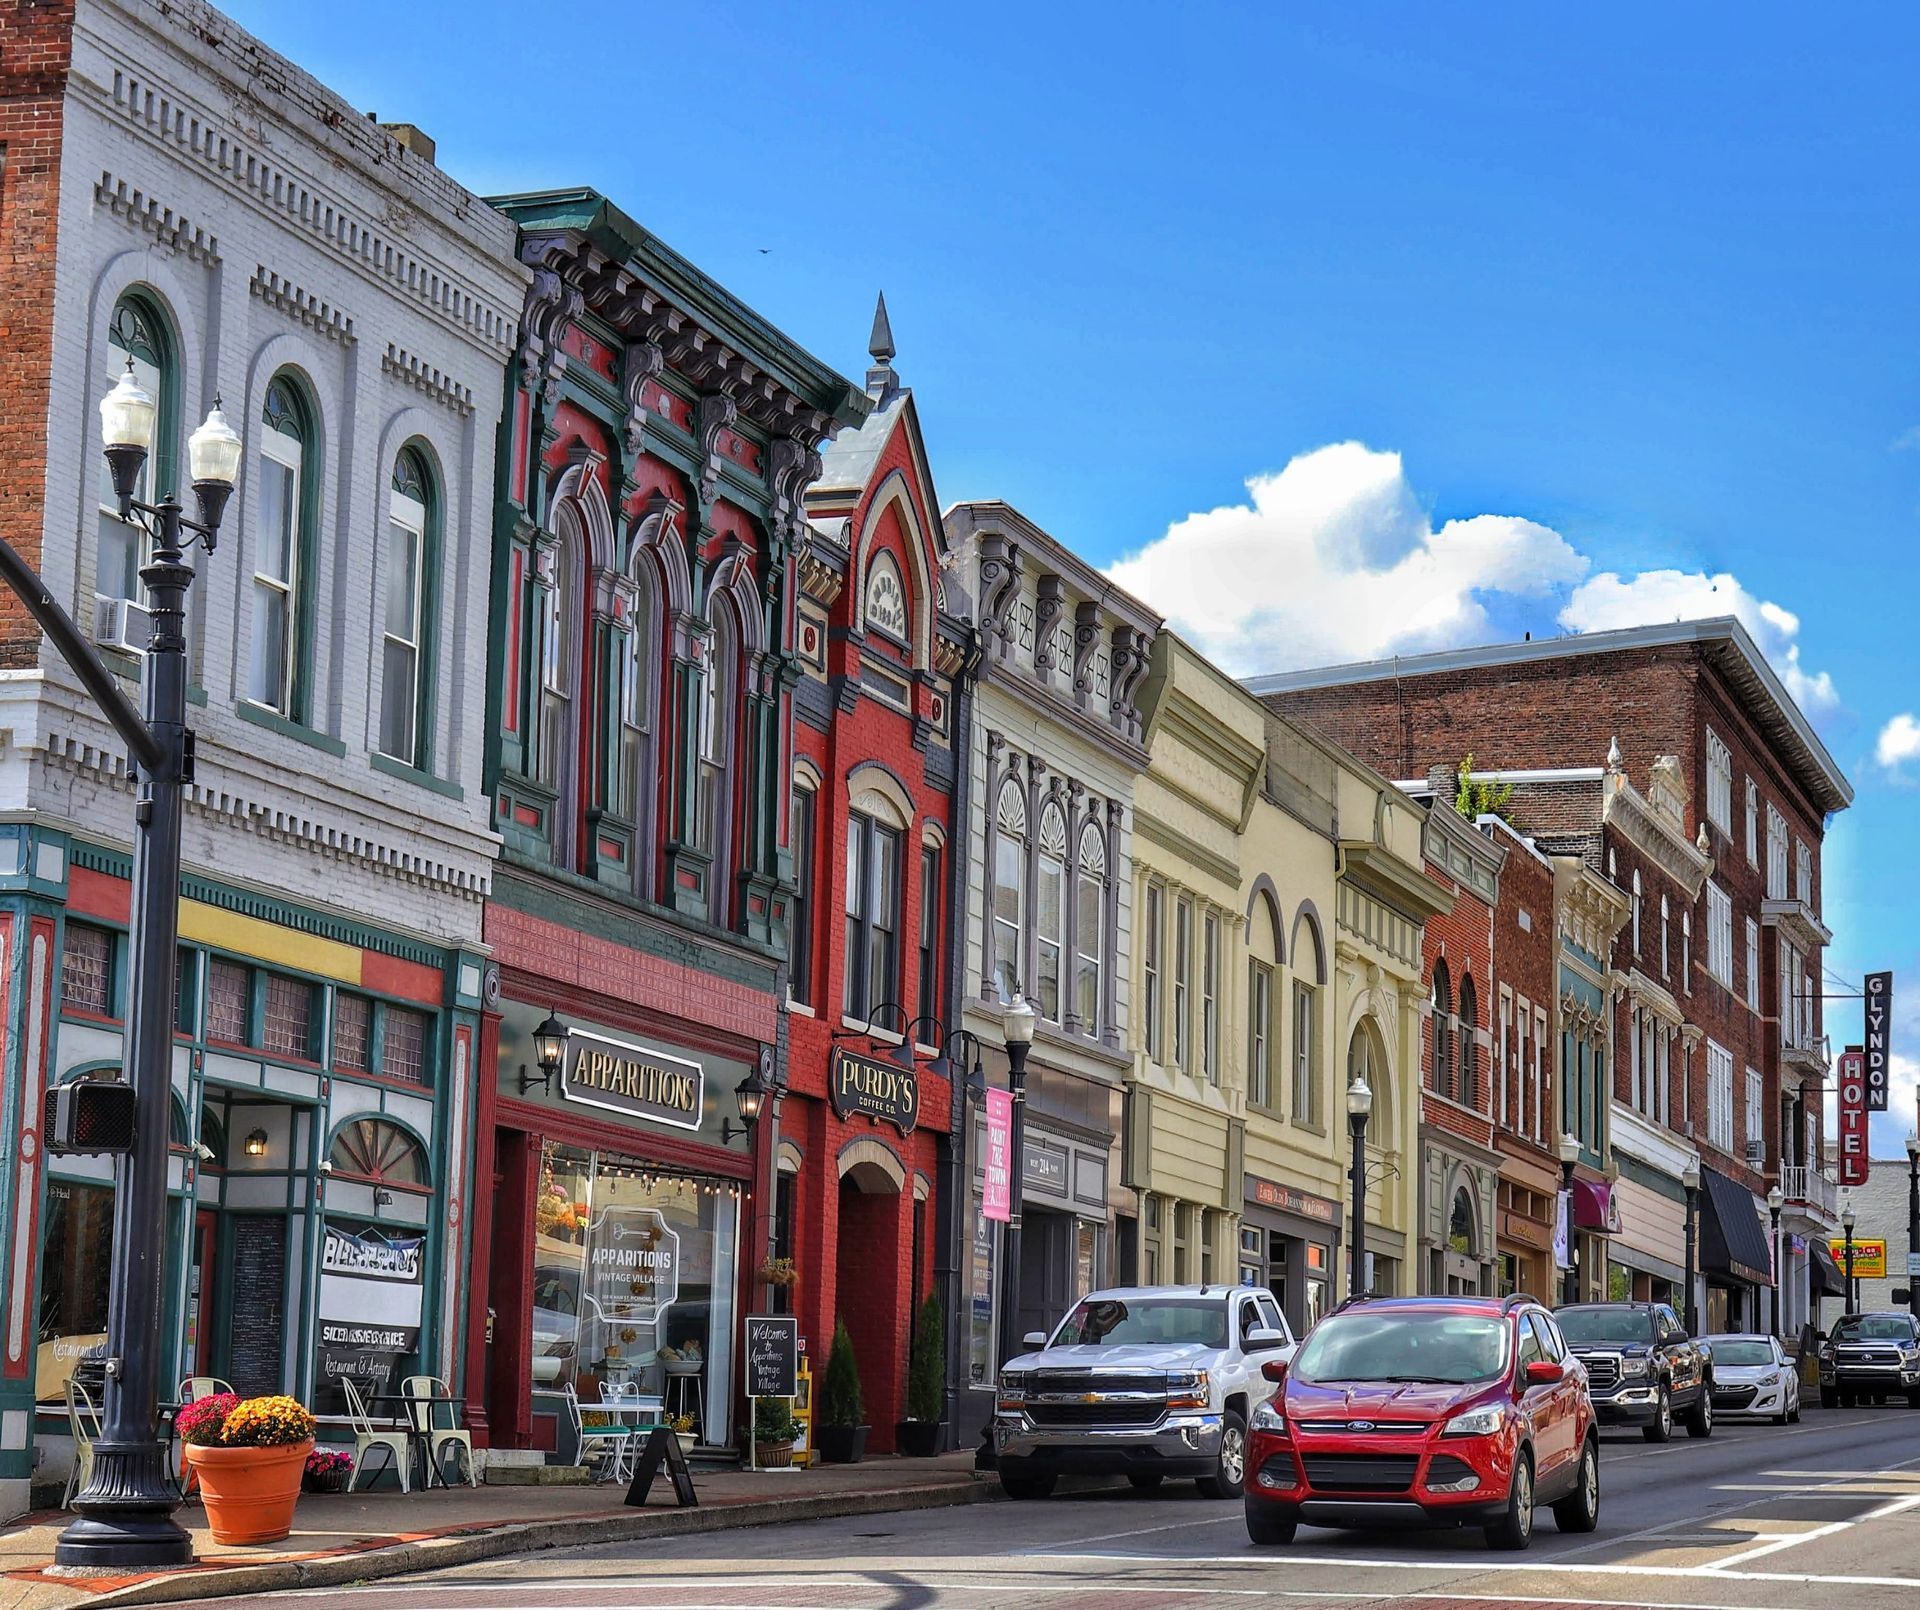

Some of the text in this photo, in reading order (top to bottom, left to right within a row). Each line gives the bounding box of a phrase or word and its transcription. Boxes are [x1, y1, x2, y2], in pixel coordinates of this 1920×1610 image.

[1868, 977, 1884, 1106] GLYNDON
[571, 1047, 696, 1112] APPARITIONS
[841, 1058, 913, 1114] PURDY'S
[858, 1096, 897, 1115] COFFEE CO.
[1843, 1059, 1861, 1178] HOTEL
[990, 1126, 1006, 1147] PAINT
[992, 1145, 1003, 1167] THE
[1039, 1158, 1050, 1175] 214
[988, 1165, 1006, 1186] TOWN
[591, 1247, 671, 1269] APPARITIONS
[597, 1272, 665, 1285] VINTAGE VILLAGE
[752, 1323, 789, 1341] Welcome
[53, 1334, 92, 1362] Restaurant
[764, 1340, 773, 1352] to
[325, 1352, 391, 1383] Restaurant & Artistry
[757, 1377, 781, 1393] Village
